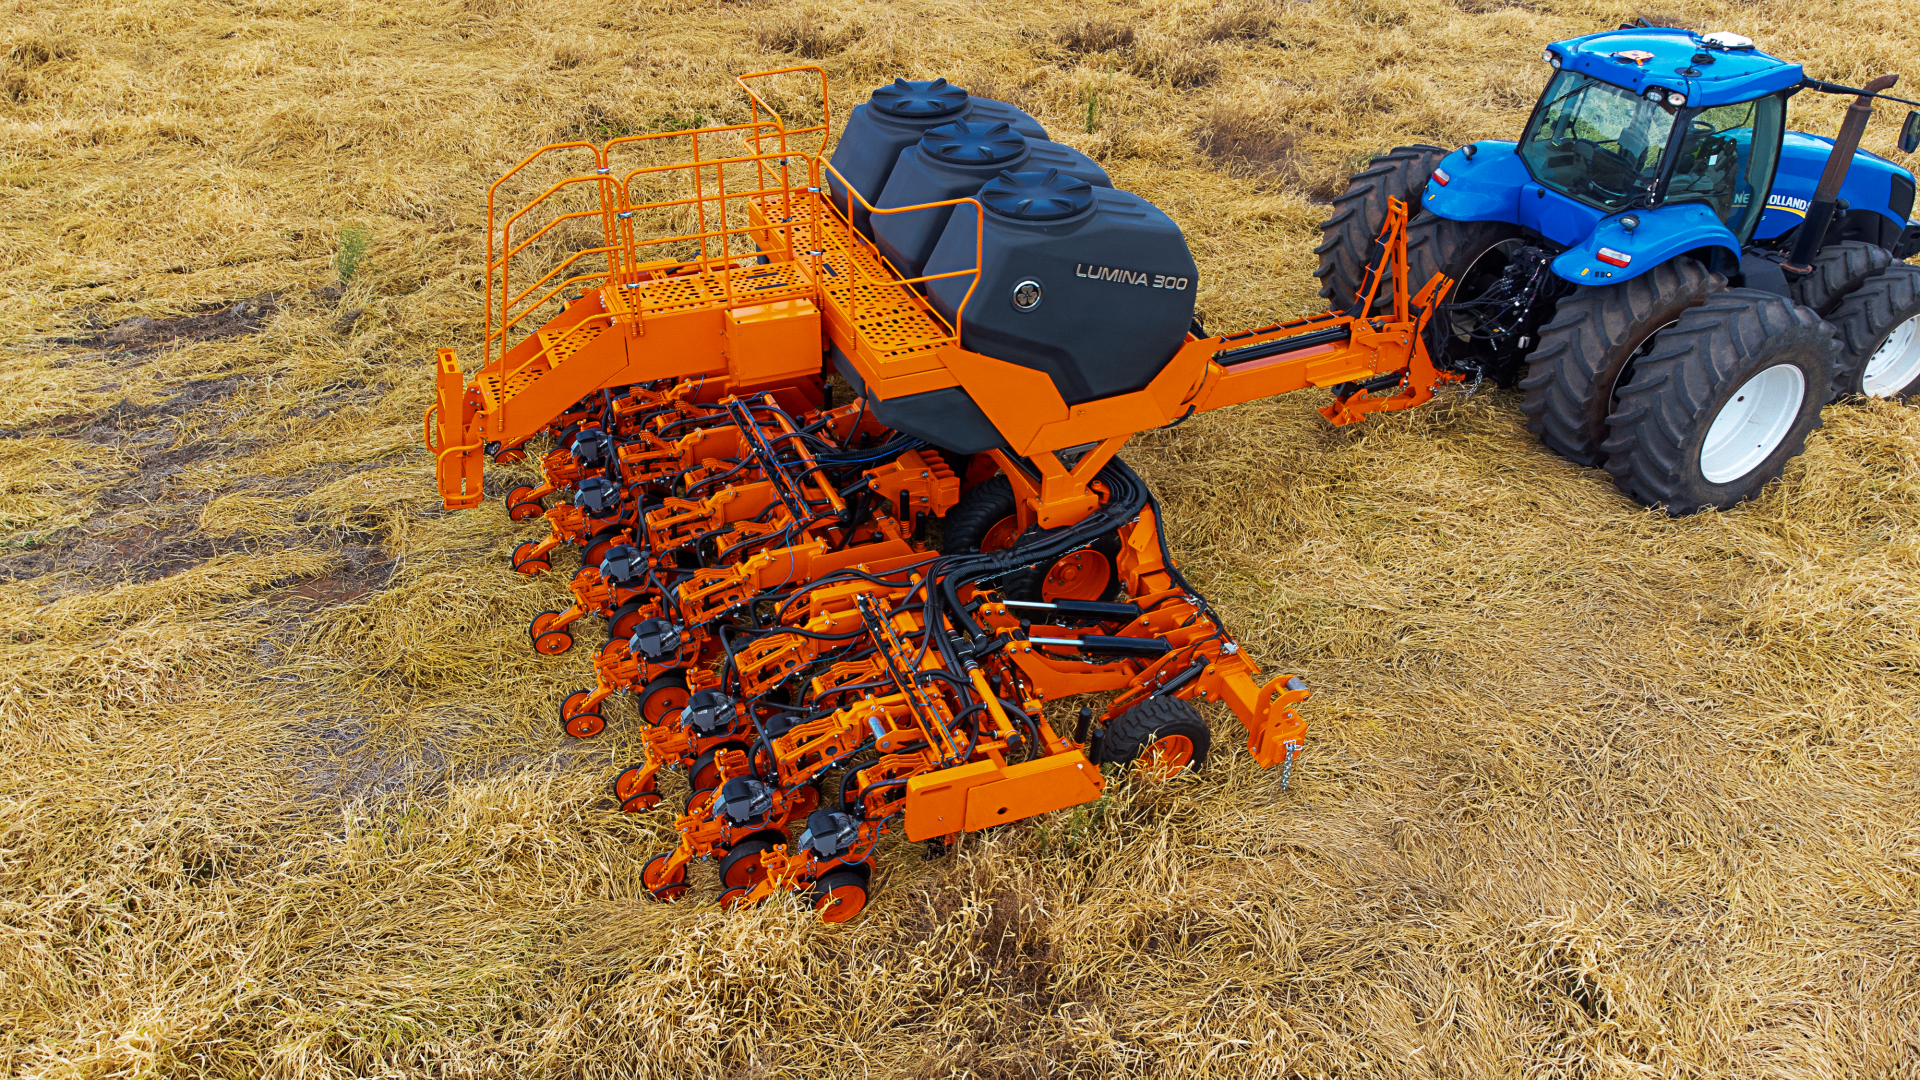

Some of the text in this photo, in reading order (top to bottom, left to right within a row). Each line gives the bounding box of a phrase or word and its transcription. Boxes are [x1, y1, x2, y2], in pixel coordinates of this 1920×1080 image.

[1733, 193, 1807, 211] NE OLLAND
[1076, 263, 1188, 291] LUMINA 300
